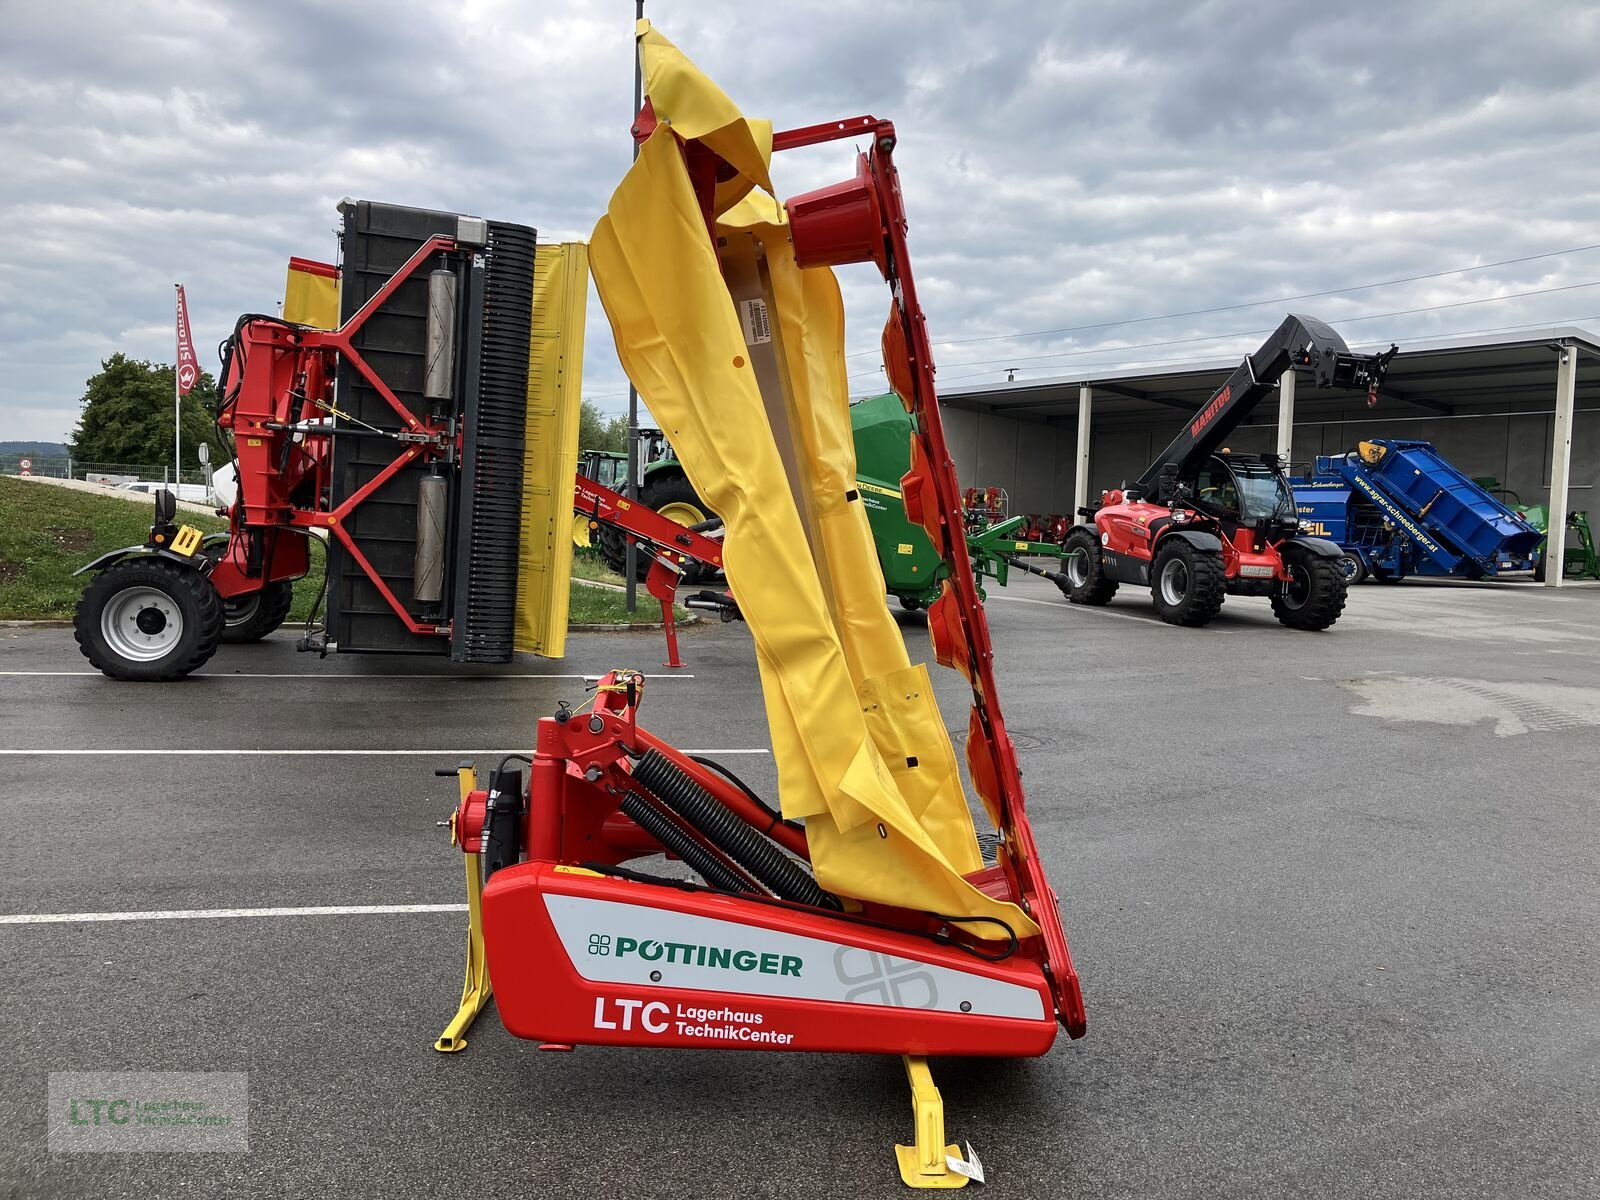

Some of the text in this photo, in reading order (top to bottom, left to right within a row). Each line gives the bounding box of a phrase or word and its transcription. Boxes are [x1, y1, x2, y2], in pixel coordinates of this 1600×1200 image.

[1191, 384, 1232, 438] MANITOU
[1354, 475, 1438, 553] www.agrar-schneeberger.at
[615, 937, 803, 977] PÖTTINGER
[594, 997, 670, 1033] LTC
[675, 1021, 794, 1044] TechnikCenter
[676, 1004, 763, 1023] Lagerhaus
